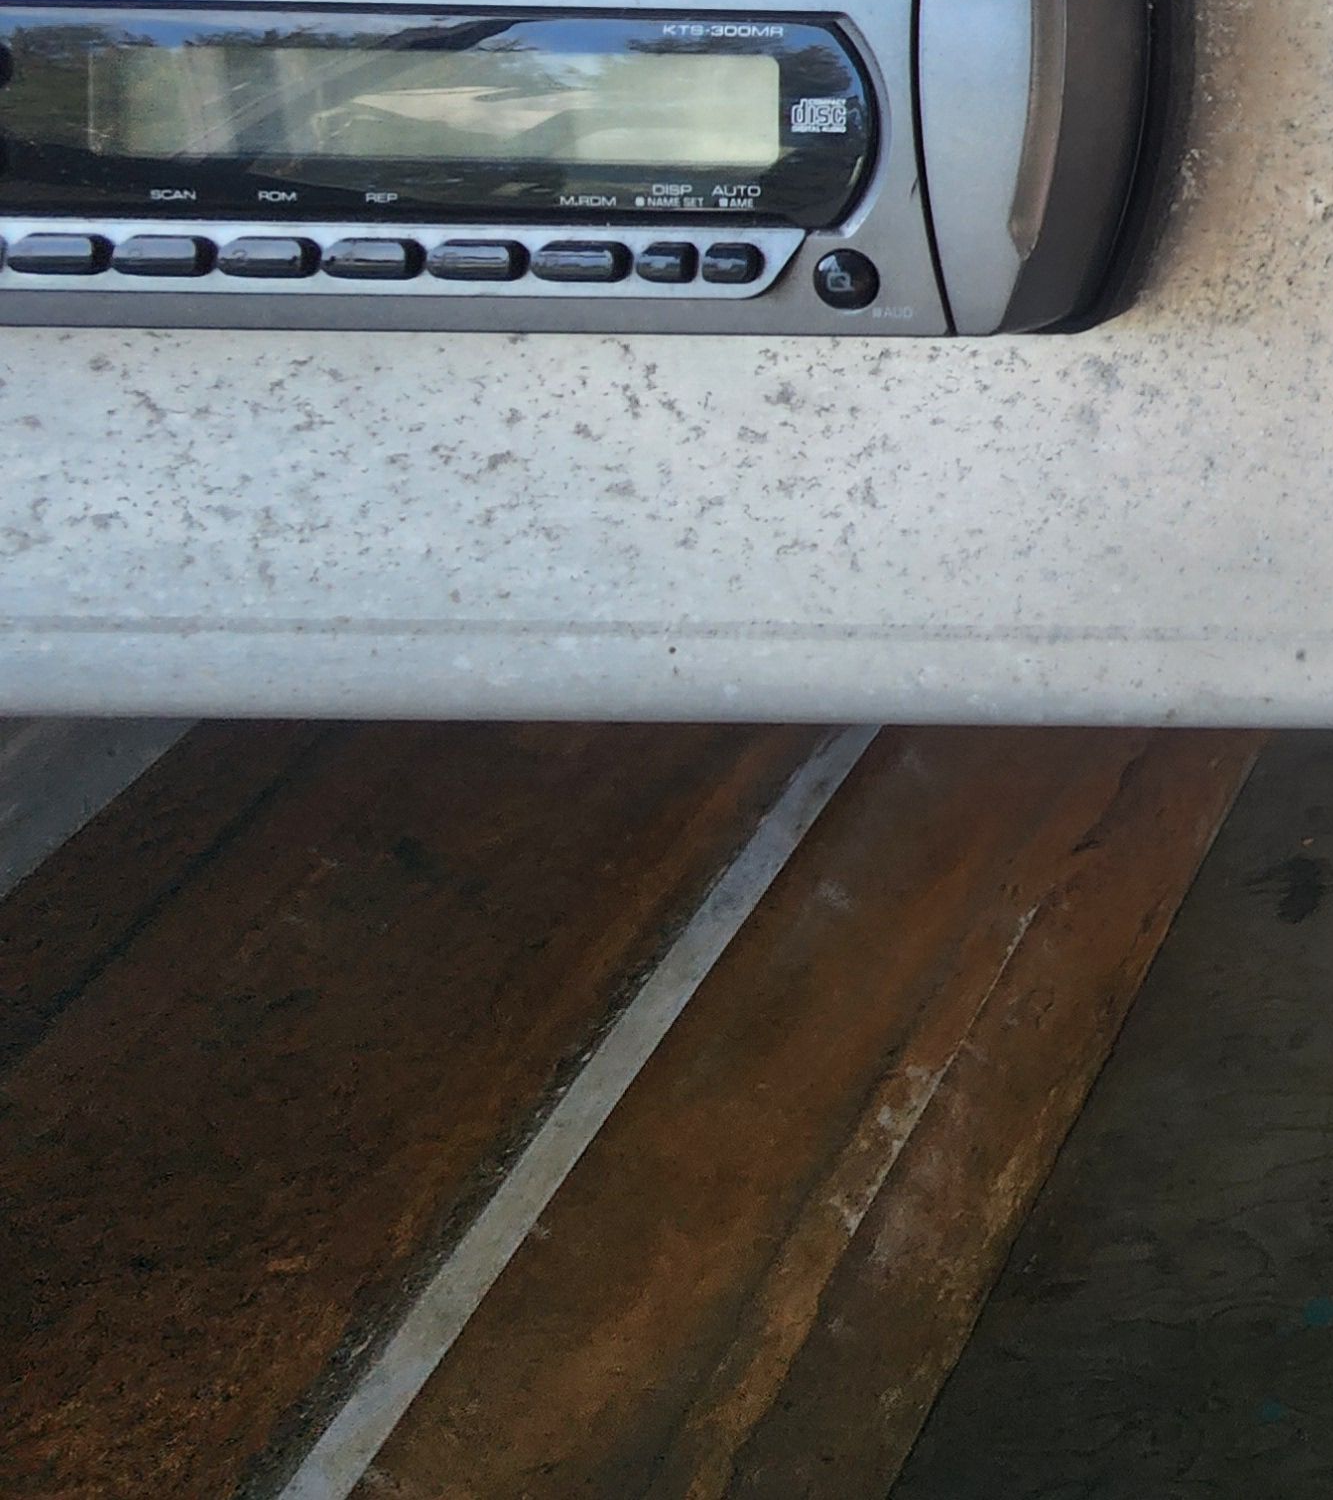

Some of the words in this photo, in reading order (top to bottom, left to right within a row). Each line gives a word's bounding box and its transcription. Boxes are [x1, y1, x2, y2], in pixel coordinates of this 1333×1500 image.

[149, 189, 197, 200] SCAN
[652, 184, 693, 195] DISP
[712, 185, 761, 196] AUTO
[365, 192, 398, 202] REP
[647, 197, 681, 207] NAME
